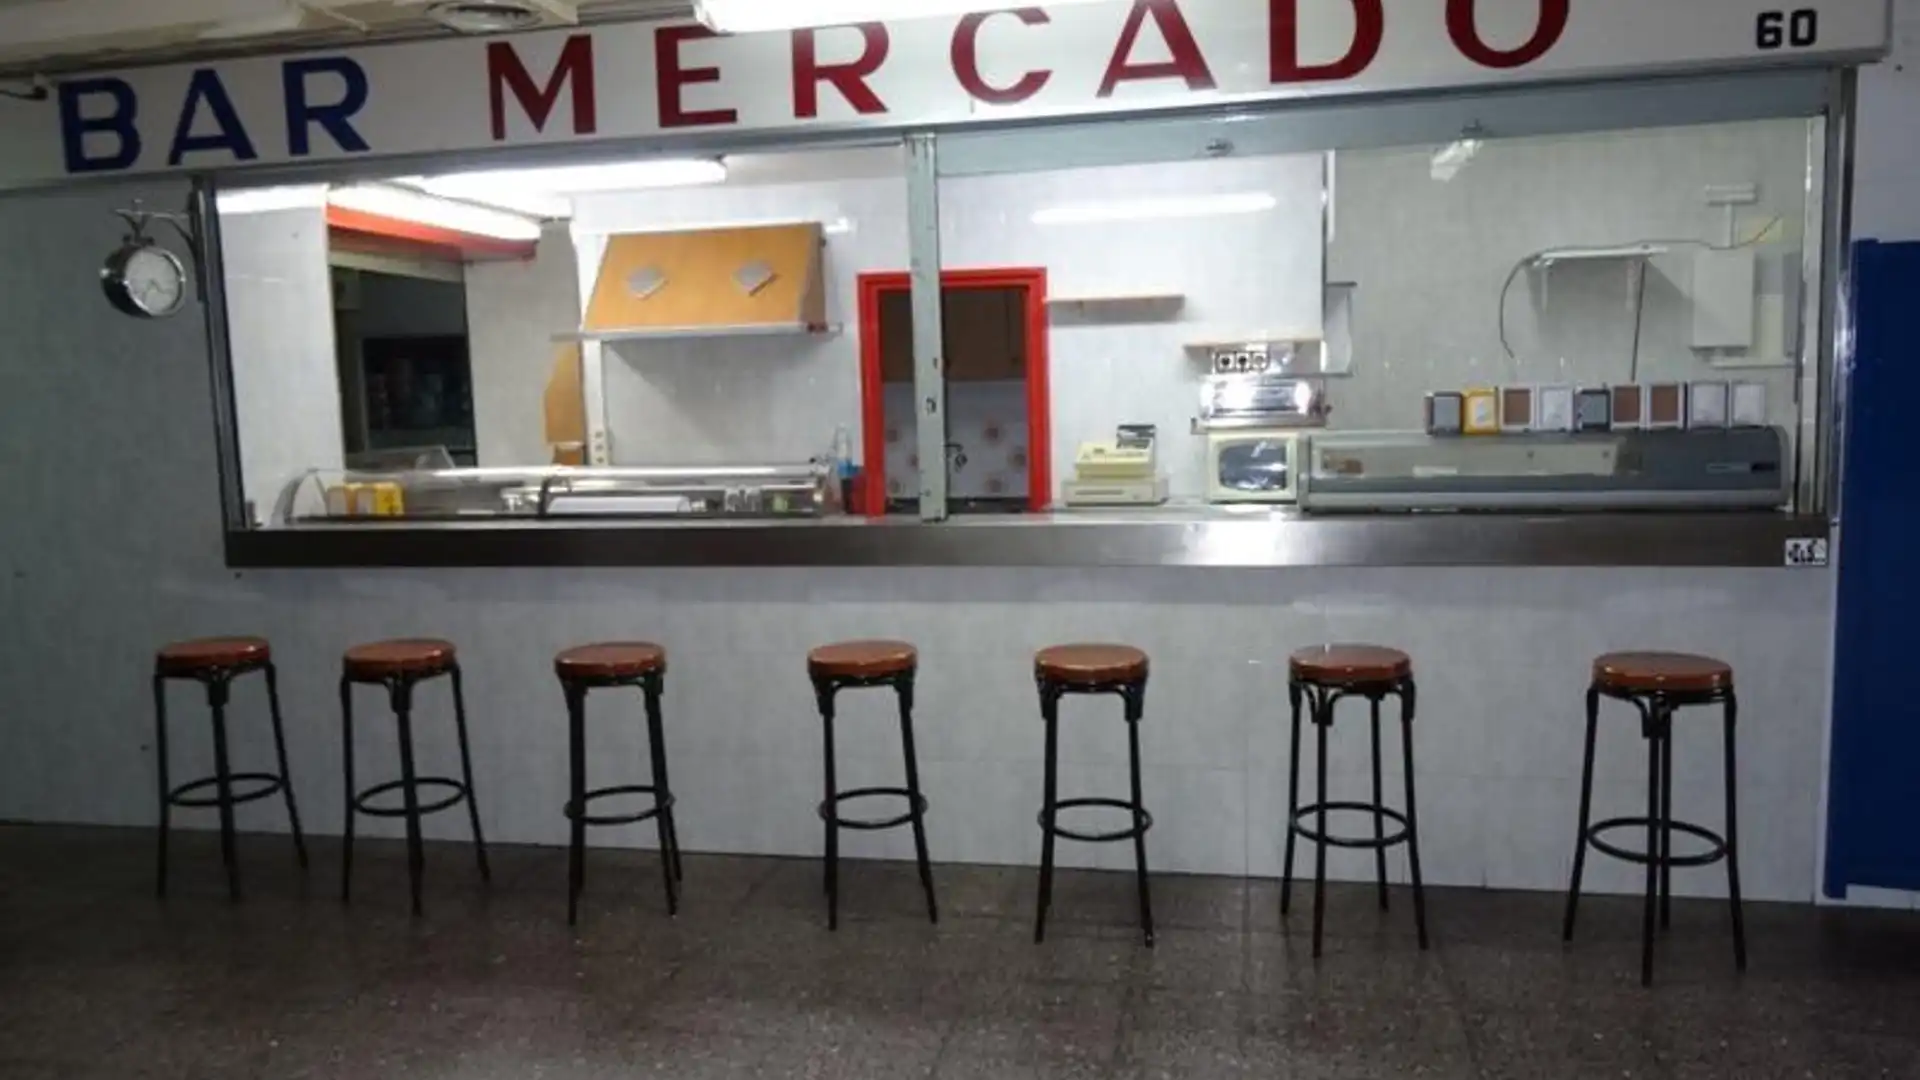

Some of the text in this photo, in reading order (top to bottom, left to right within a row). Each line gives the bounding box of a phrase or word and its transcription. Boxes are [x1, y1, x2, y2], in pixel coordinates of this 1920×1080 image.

[1756, 9, 1817, 49] 60
[58, 0, 1570, 173] BAR MERCADO
